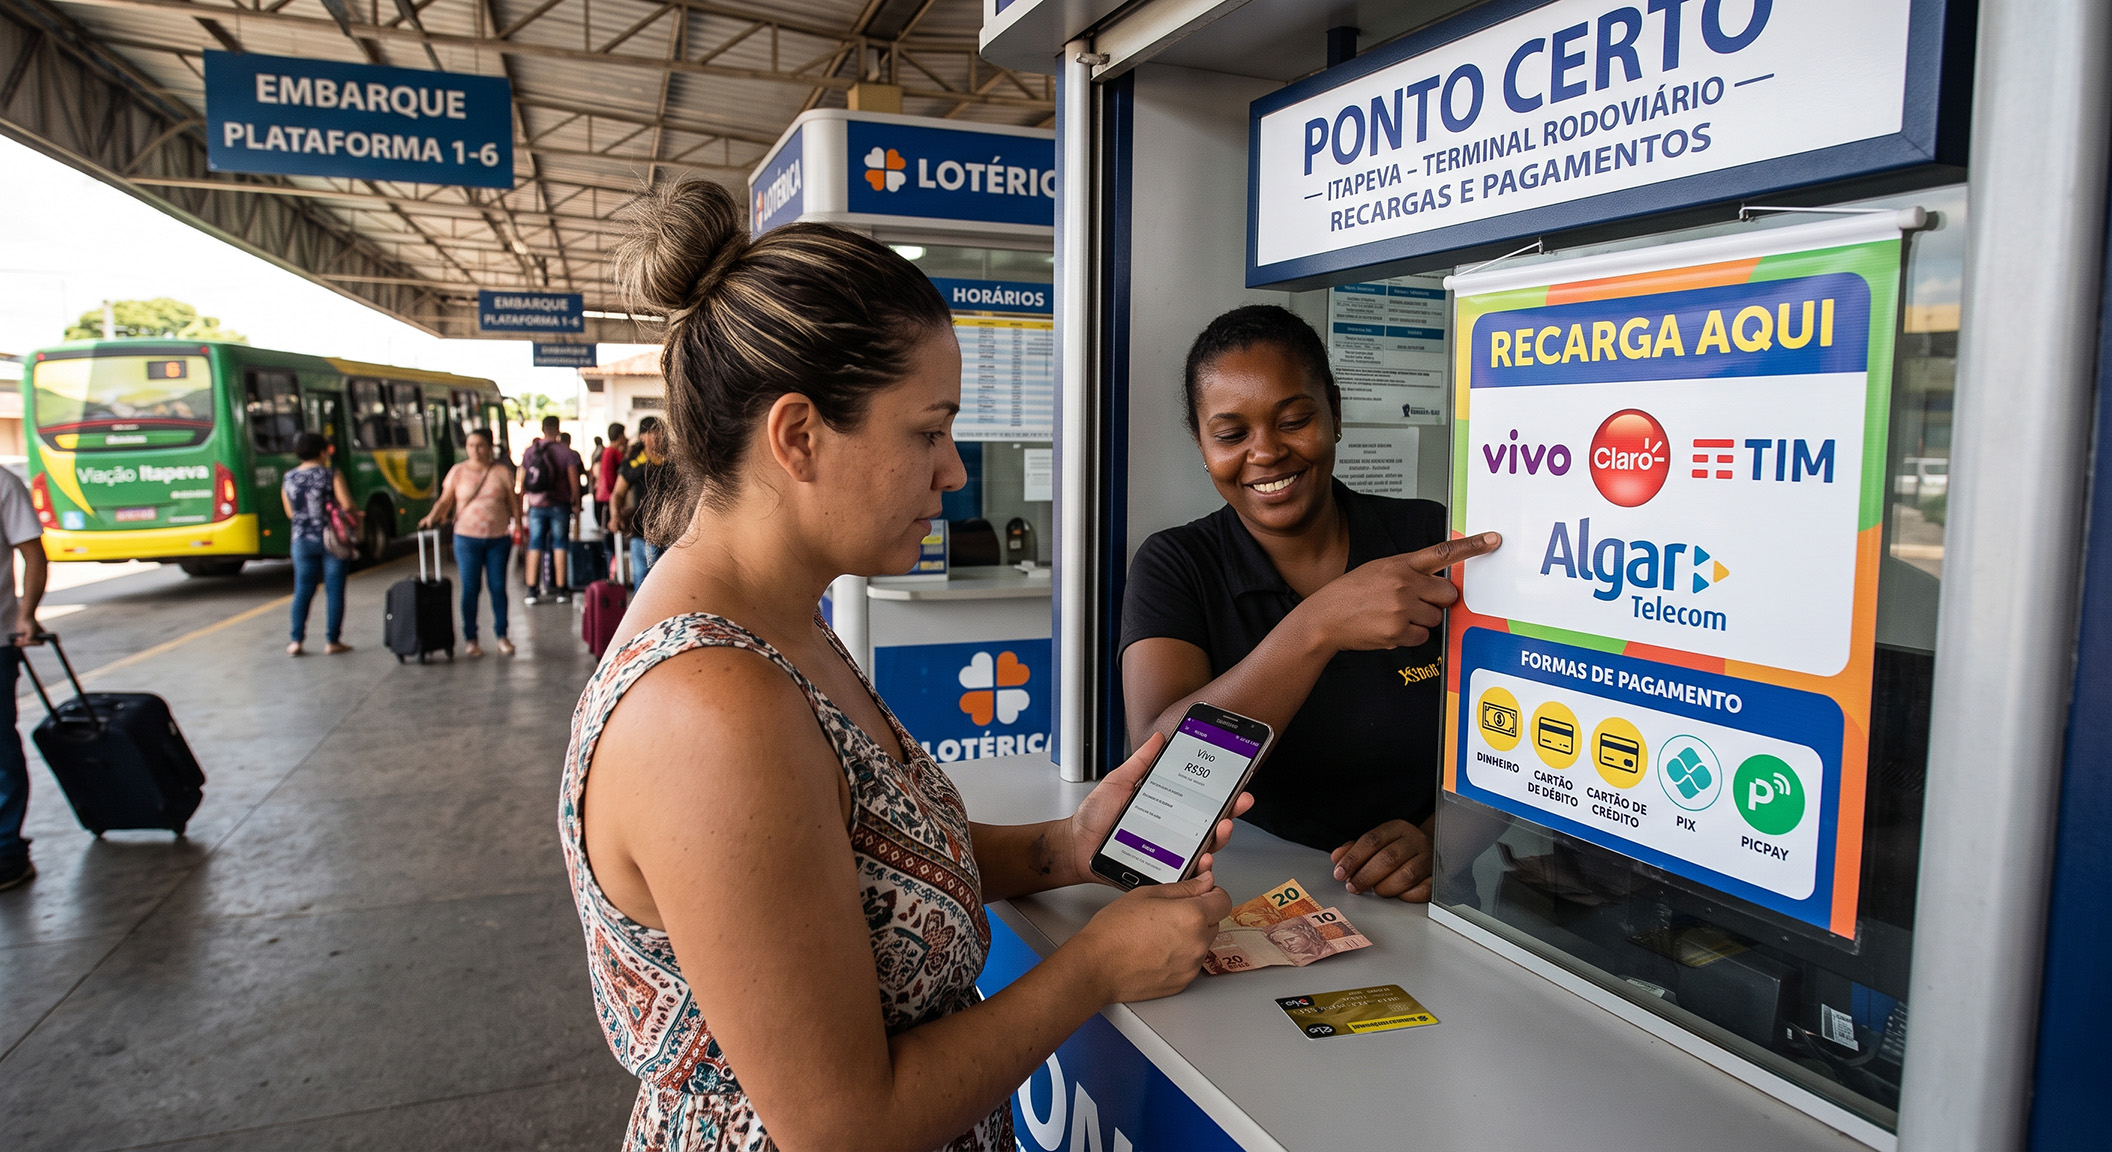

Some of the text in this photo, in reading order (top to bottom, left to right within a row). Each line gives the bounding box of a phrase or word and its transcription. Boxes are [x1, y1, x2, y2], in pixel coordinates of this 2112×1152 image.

[255, 73, 467, 119] EMBARQUE
[1303, 0, 1773, 176] PONTO CERTO
[223, 122, 500, 167] PLATAFORMA 1-6
[1327, 164, 1402, 200] ITAPEVA
[1423, 133, 1536, 176] TERMINAL
[1544, 76, 1725, 147] RODOVIÁRIO
[763, 158, 802, 223] LOTÉRICA
[1330, 122, 1712, 232] RECARGAS E PAGAMENTOS
[494, 296, 569, 312] EMBARQUE
[953, 285, 1045, 307] HORÁRIOS
[483, 313, 580, 328] PLATAFORMA 1-6
[1490, 298, 1835, 368] RECARGA AQUI
[1482, 428, 1572, 477] vivo
[1593, 446, 1653, 471] Claro
[1744, 438, 1836, 484] TIM
[76, 464, 209, 486] Viação Itapeva
[1540, 517, 1687, 602] Algar
[1631, 595, 1727, 631] Telecom
[1521, 650, 1743, 714] FORMAS DE PAGAMENTO
[921, 730, 1052, 763] LOTÉRIC
[1197, 748, 1216, 763] Vivo
[1476, 752, 1520, 774] DINHEIRO
[1533, 770, 1574, 791] CARTÃO
[1527, 781, 1579, 808] DE DÉBITO
[1586, 787, 1647, 816] CARTÃO DE
[1591, 803, 1640, 829] CRÉDITO
[1676, 815, 1697, 833] PIX
[1740, 835, 1790, 862] PICPAY
[1272, 887, 1300, 908] 20
[1311, 912, 1337, 925] 10
[1222, 955, 1243, 966] 20
